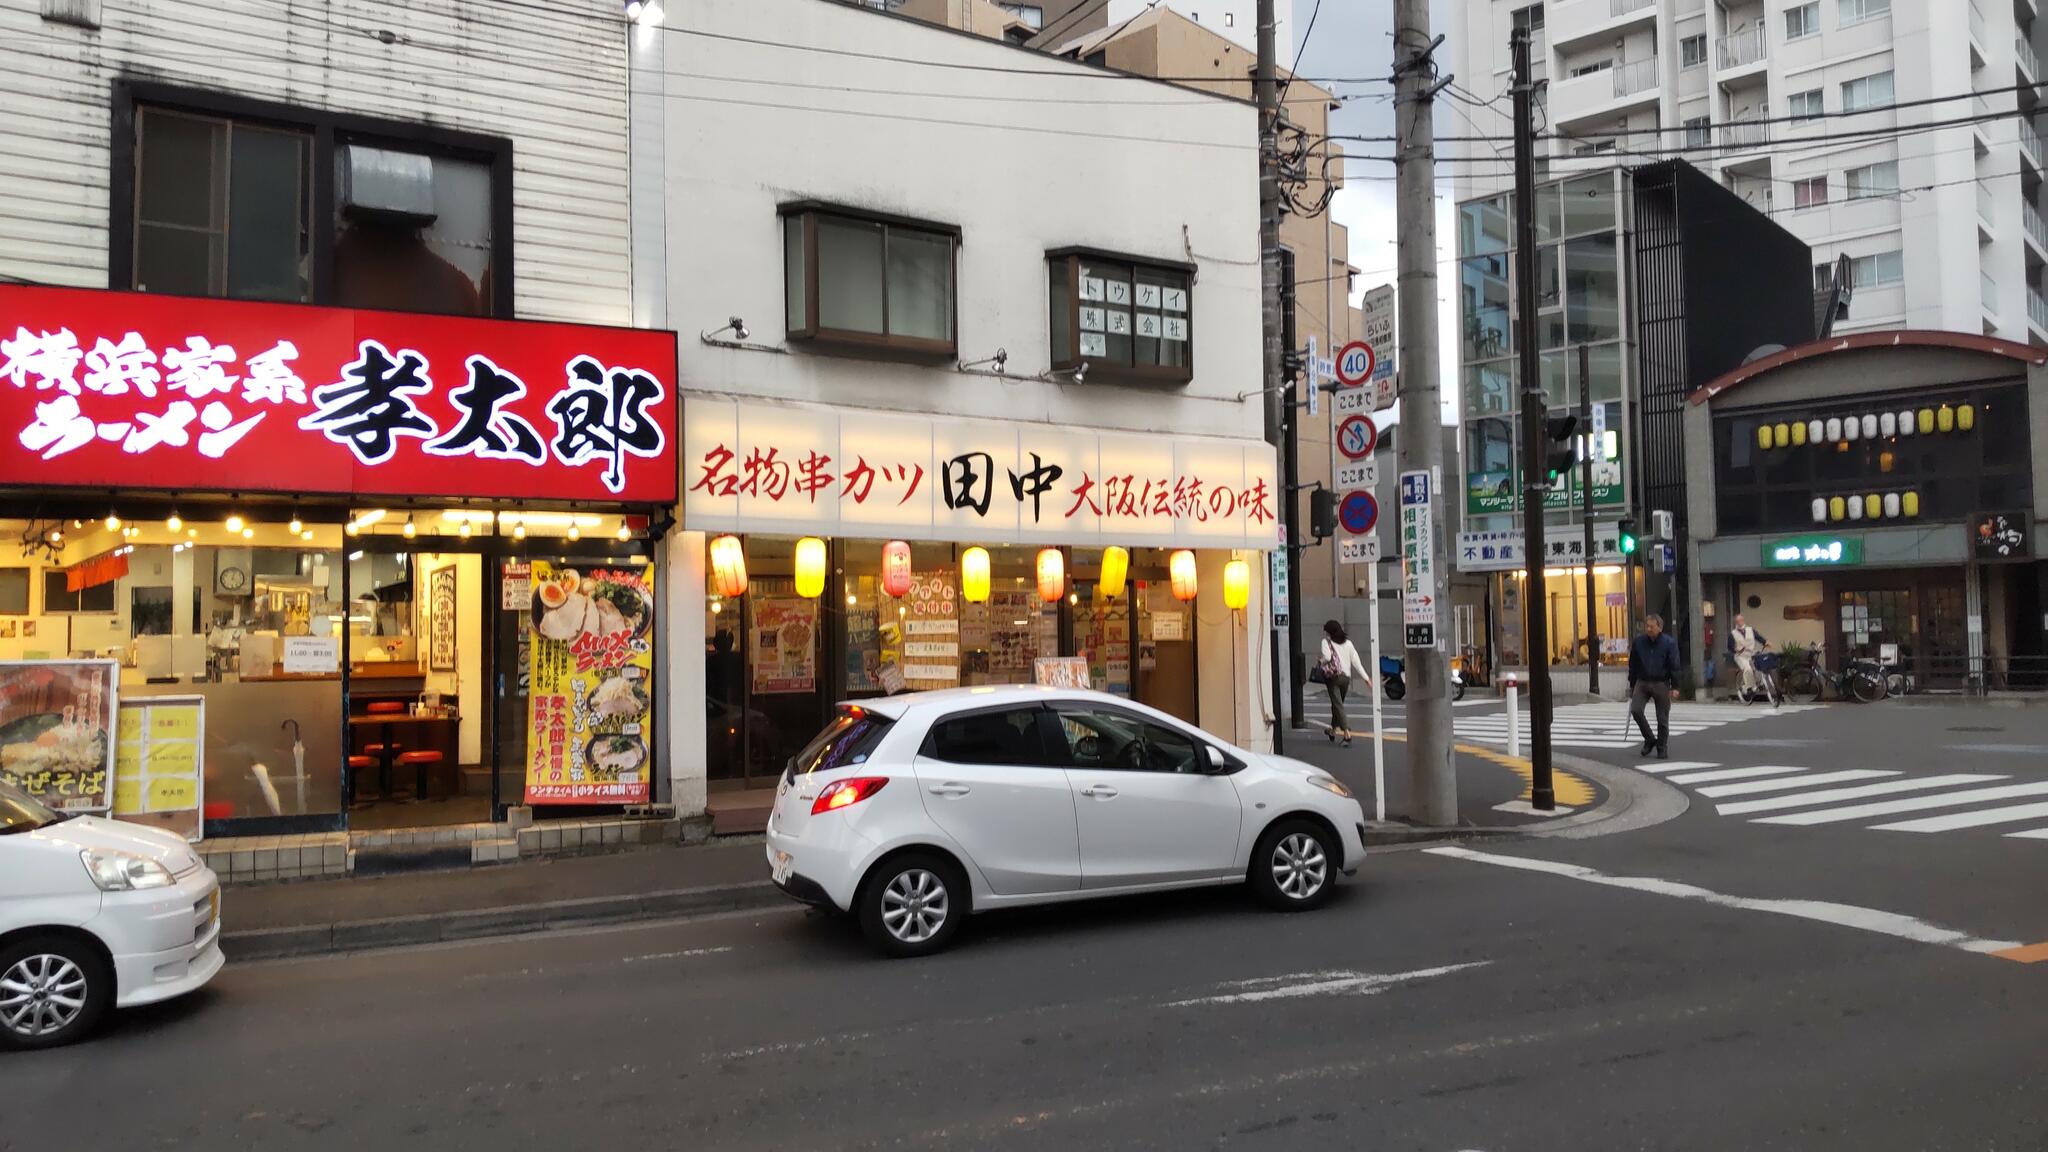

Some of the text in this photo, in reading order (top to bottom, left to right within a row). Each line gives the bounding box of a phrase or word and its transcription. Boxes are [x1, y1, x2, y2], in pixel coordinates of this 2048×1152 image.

[1085, 280, 1180, 308] トウケイ
[1086, 310, 1181, 337] 株式会社
[0, 326, 307, 404] 横浜家系
[1345, 353, 1366, 374] 40
[1340, 391, 1371, 409] ここまで
[19, 395, 266, 460] ラーメン
[298, 339, 664, 493] 孝太郎
[689, 443, 1274, 526] 名物串カツ 田中 大阪伝統の味
[1341, 467, 1373, 484] ここまで
[1343, 542, 1375, 558] ここまで
[1464, 545, 1512, 560] 不動産
